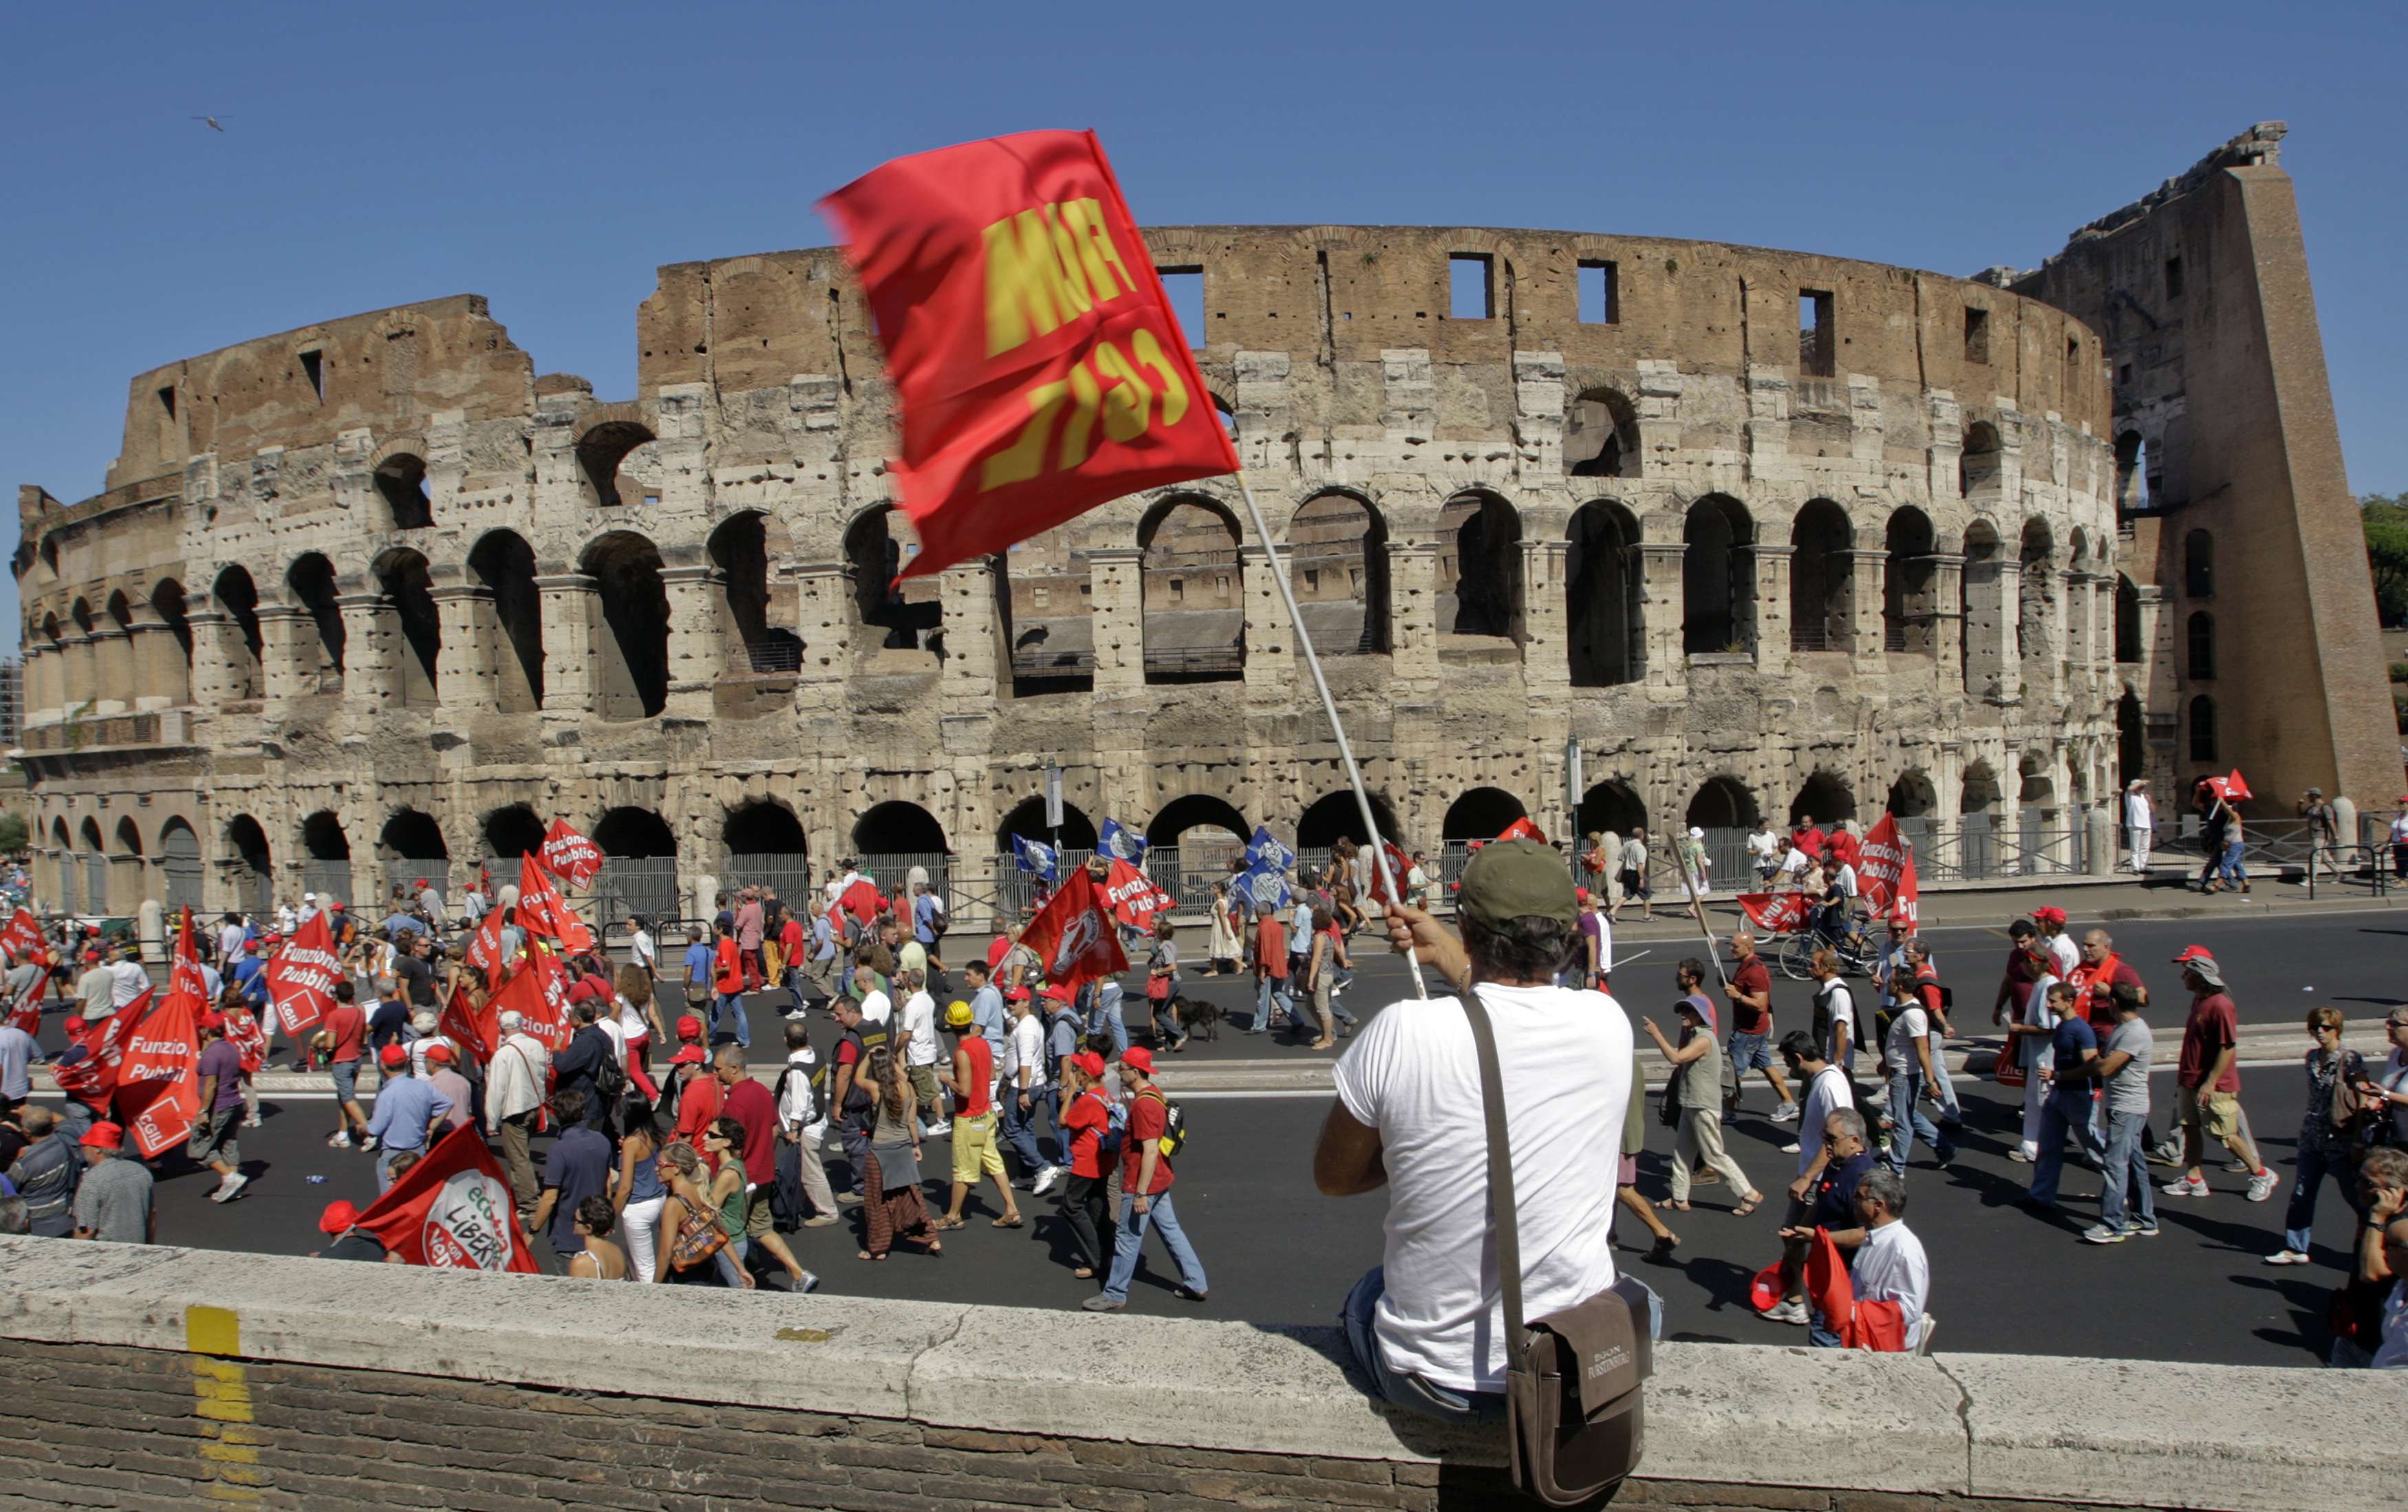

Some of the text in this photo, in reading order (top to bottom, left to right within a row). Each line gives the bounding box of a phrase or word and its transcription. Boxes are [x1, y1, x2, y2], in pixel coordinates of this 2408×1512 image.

[544, 834, 588, 856] Funzione
[279, 941, 343, 975] Funzione
[282, 1002, 299, 1026] CGIL
[128, 1035, 202, 1059] Funzio
[139, 1113, 164, 1147] CGIL
[448, 1240, 462, 1260] con
